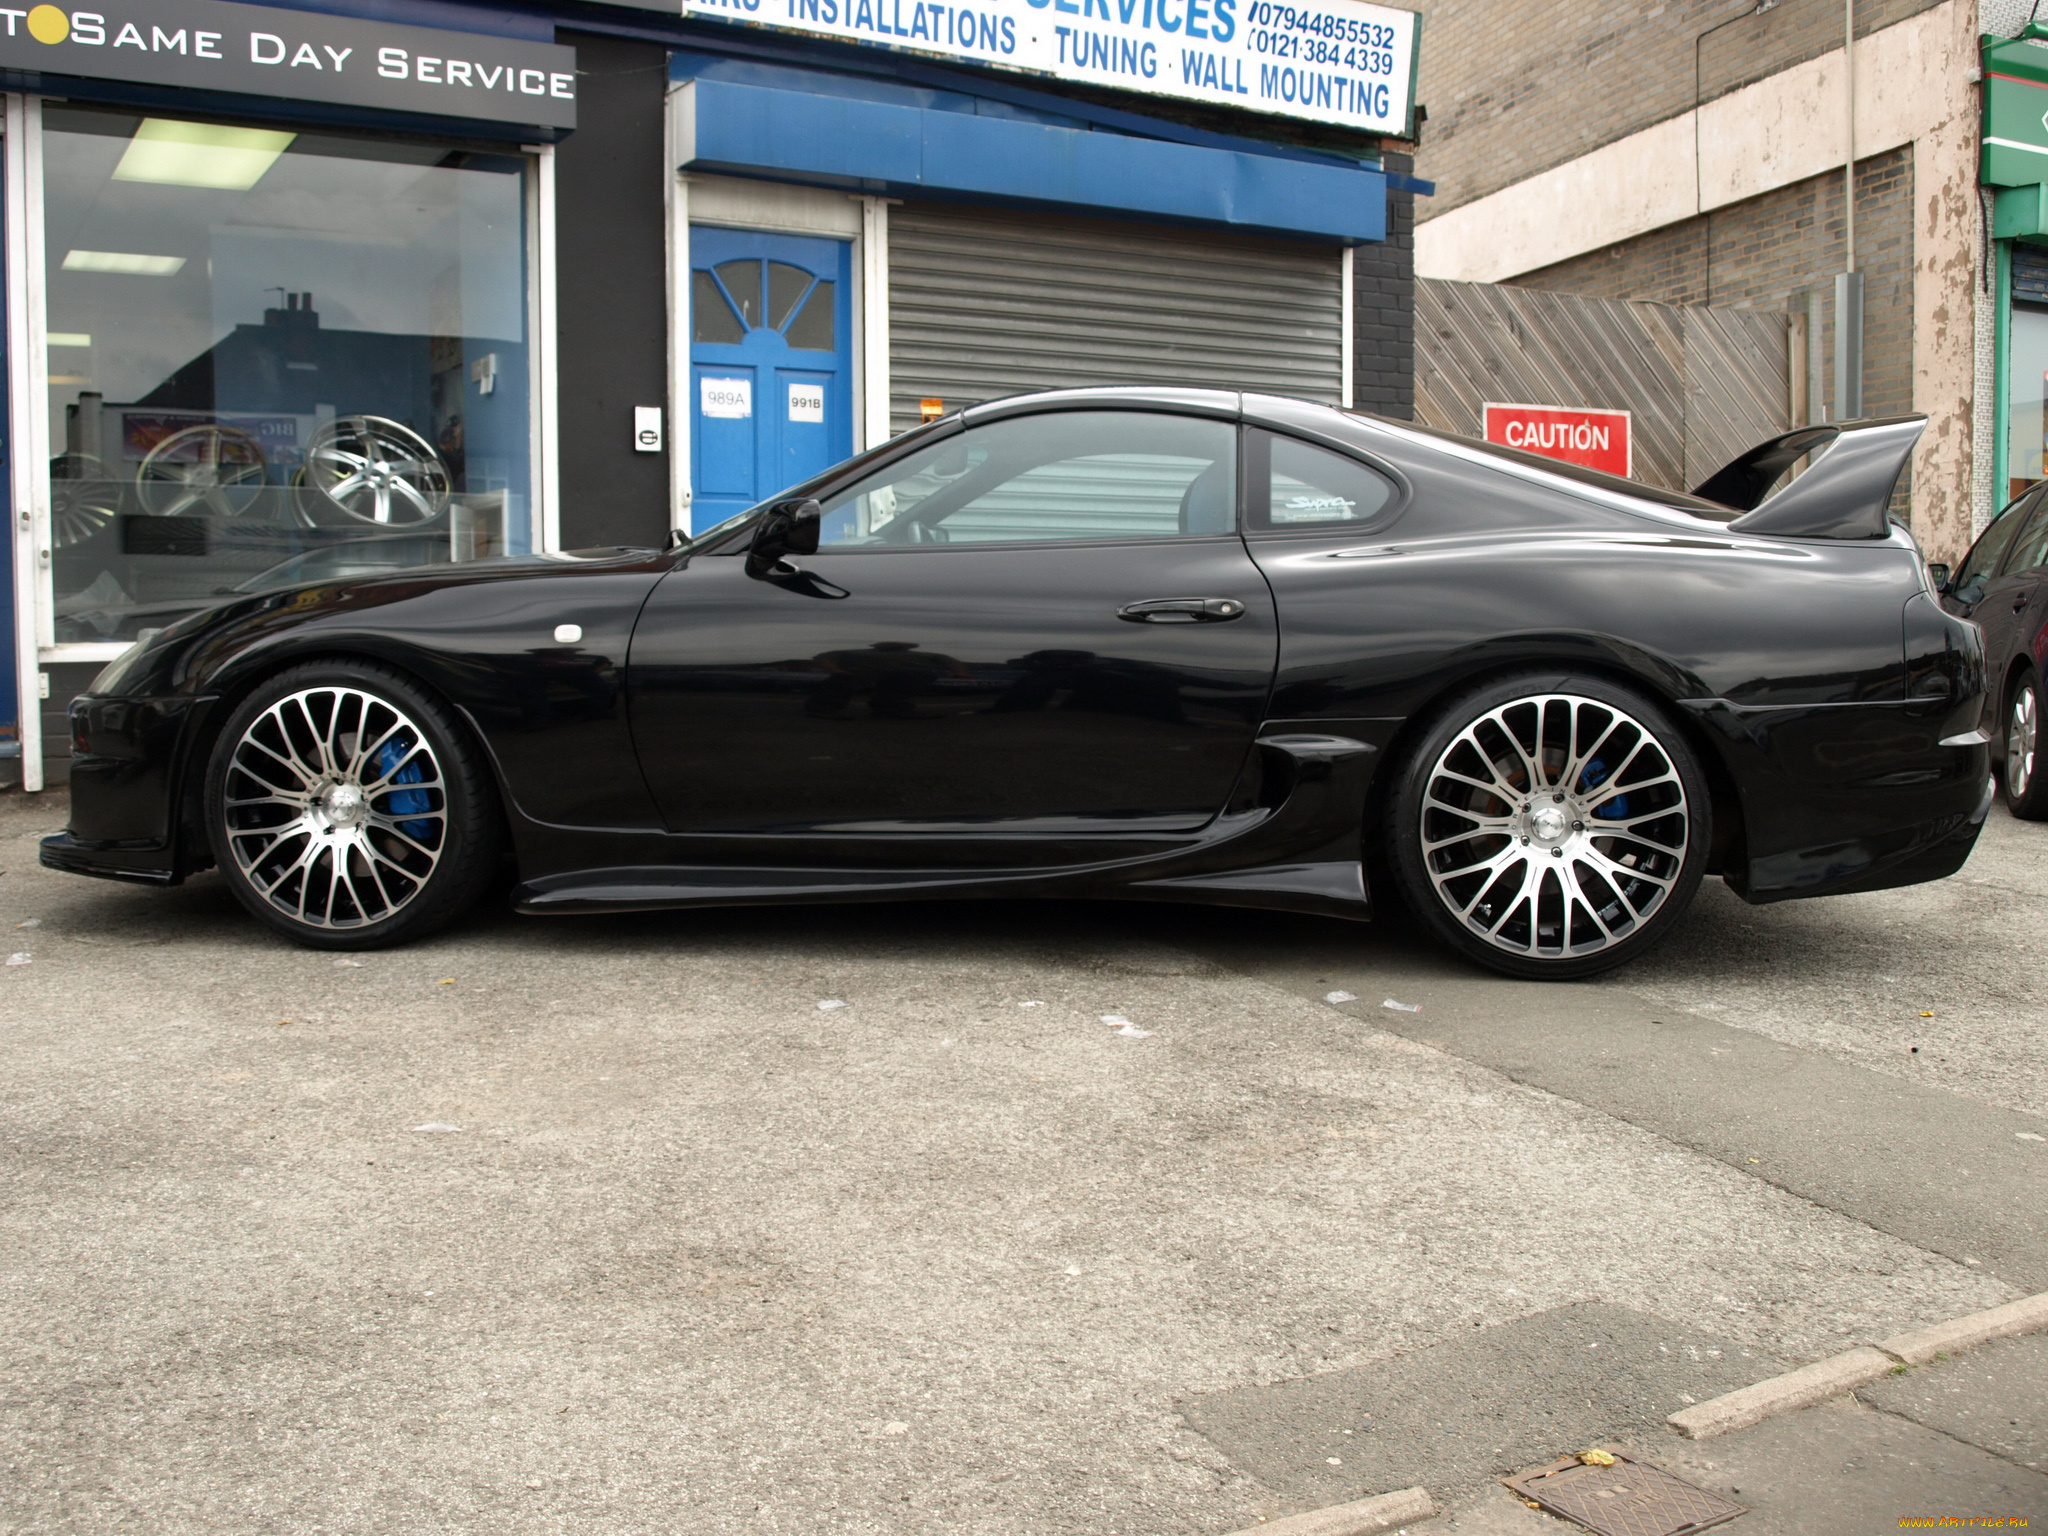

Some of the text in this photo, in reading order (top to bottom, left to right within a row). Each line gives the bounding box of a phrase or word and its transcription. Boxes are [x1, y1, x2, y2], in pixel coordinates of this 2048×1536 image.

[1025, 0, 1236, 43] VICES
[1259, 3, 1394, 50] 07944855532
[1055, 26, 1157, 79] TUNING
[1182, 48, 1248, 95] WALL
[1261, 64, 1389, 119] MOUNTING
[707, 391, 745, 406] 989A
[791, 397, 821, 410] 991B
[1505, 420, 1609, 451] CAUTION
